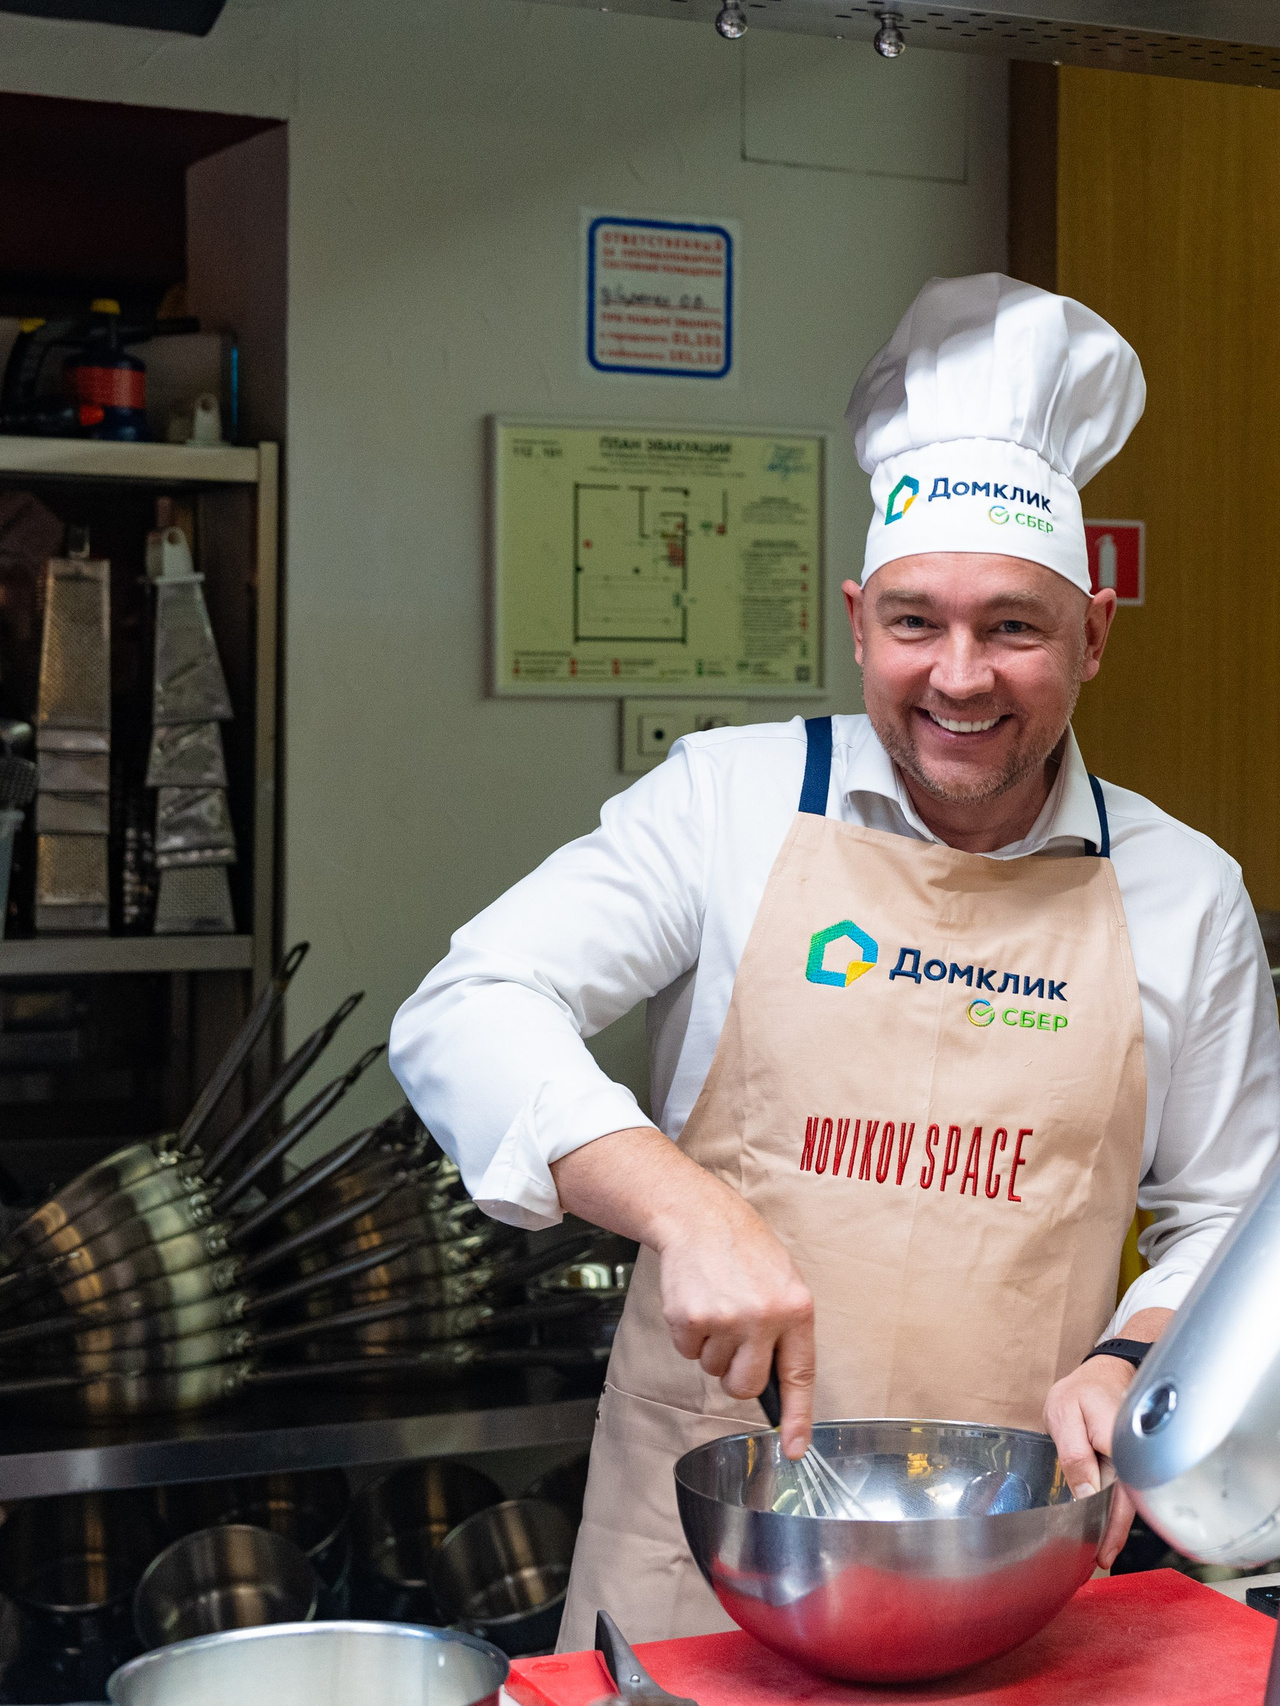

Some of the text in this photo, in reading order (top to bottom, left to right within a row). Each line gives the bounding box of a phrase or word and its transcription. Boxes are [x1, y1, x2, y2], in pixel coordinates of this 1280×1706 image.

[599, 436, 732, 457] ПЛАН ЭВАКУАЦИИ
[1015, 512, 1054, 534] СБЕР
[1002, 1008, 1068, 1032] СБЕР
[800, 1116, 1034, 1202] NOVIKOV SPACE
